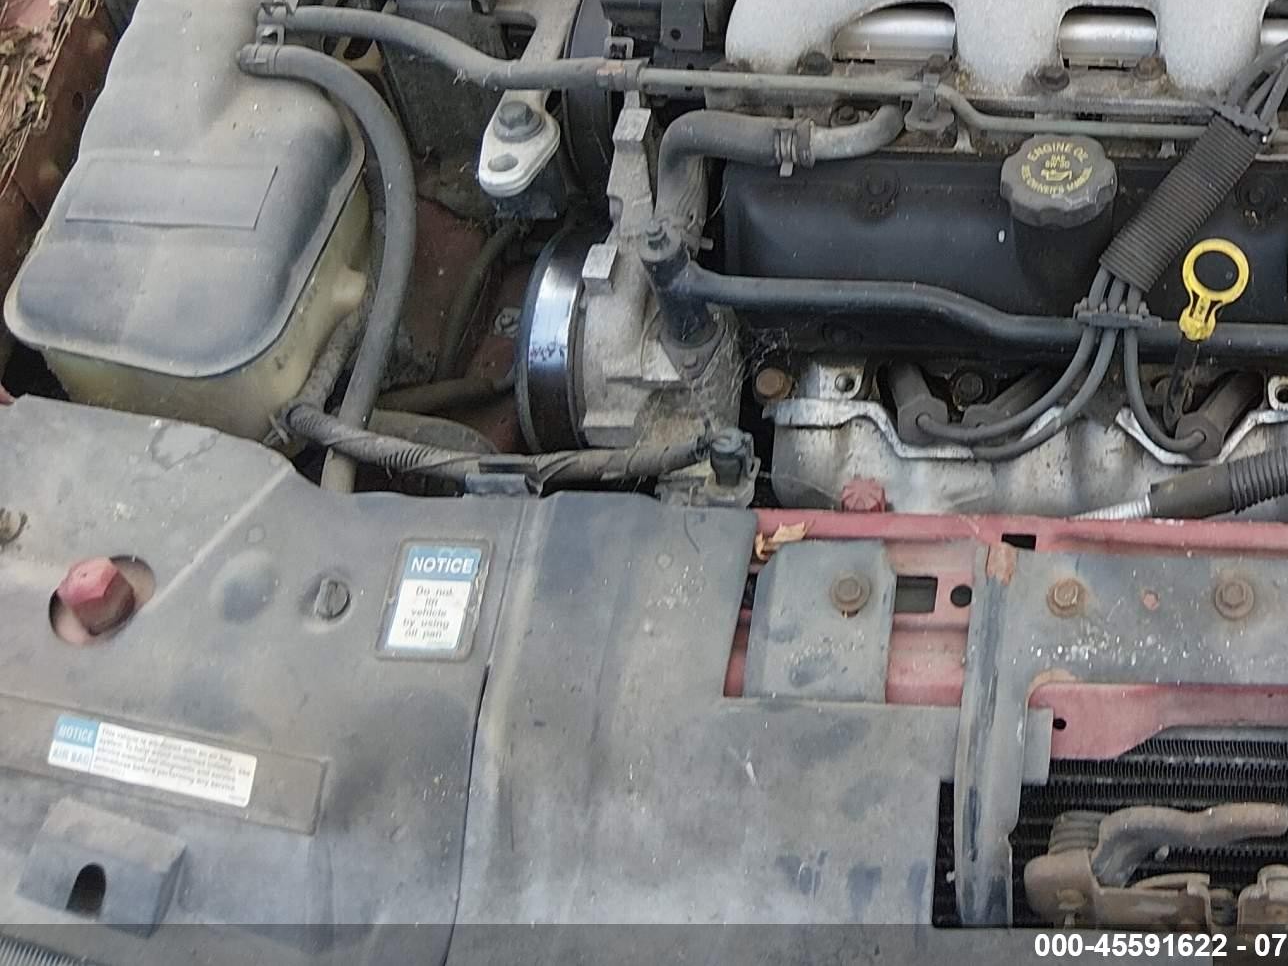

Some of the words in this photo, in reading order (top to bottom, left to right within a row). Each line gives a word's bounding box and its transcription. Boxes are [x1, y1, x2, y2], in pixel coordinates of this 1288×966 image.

[1026, 141, 1075, 162] ENGINE
[411, 556, 475, 575] NOTICE
[415, 585, 430, 596] Do
[57, 725, 95, 742] NOTICE
